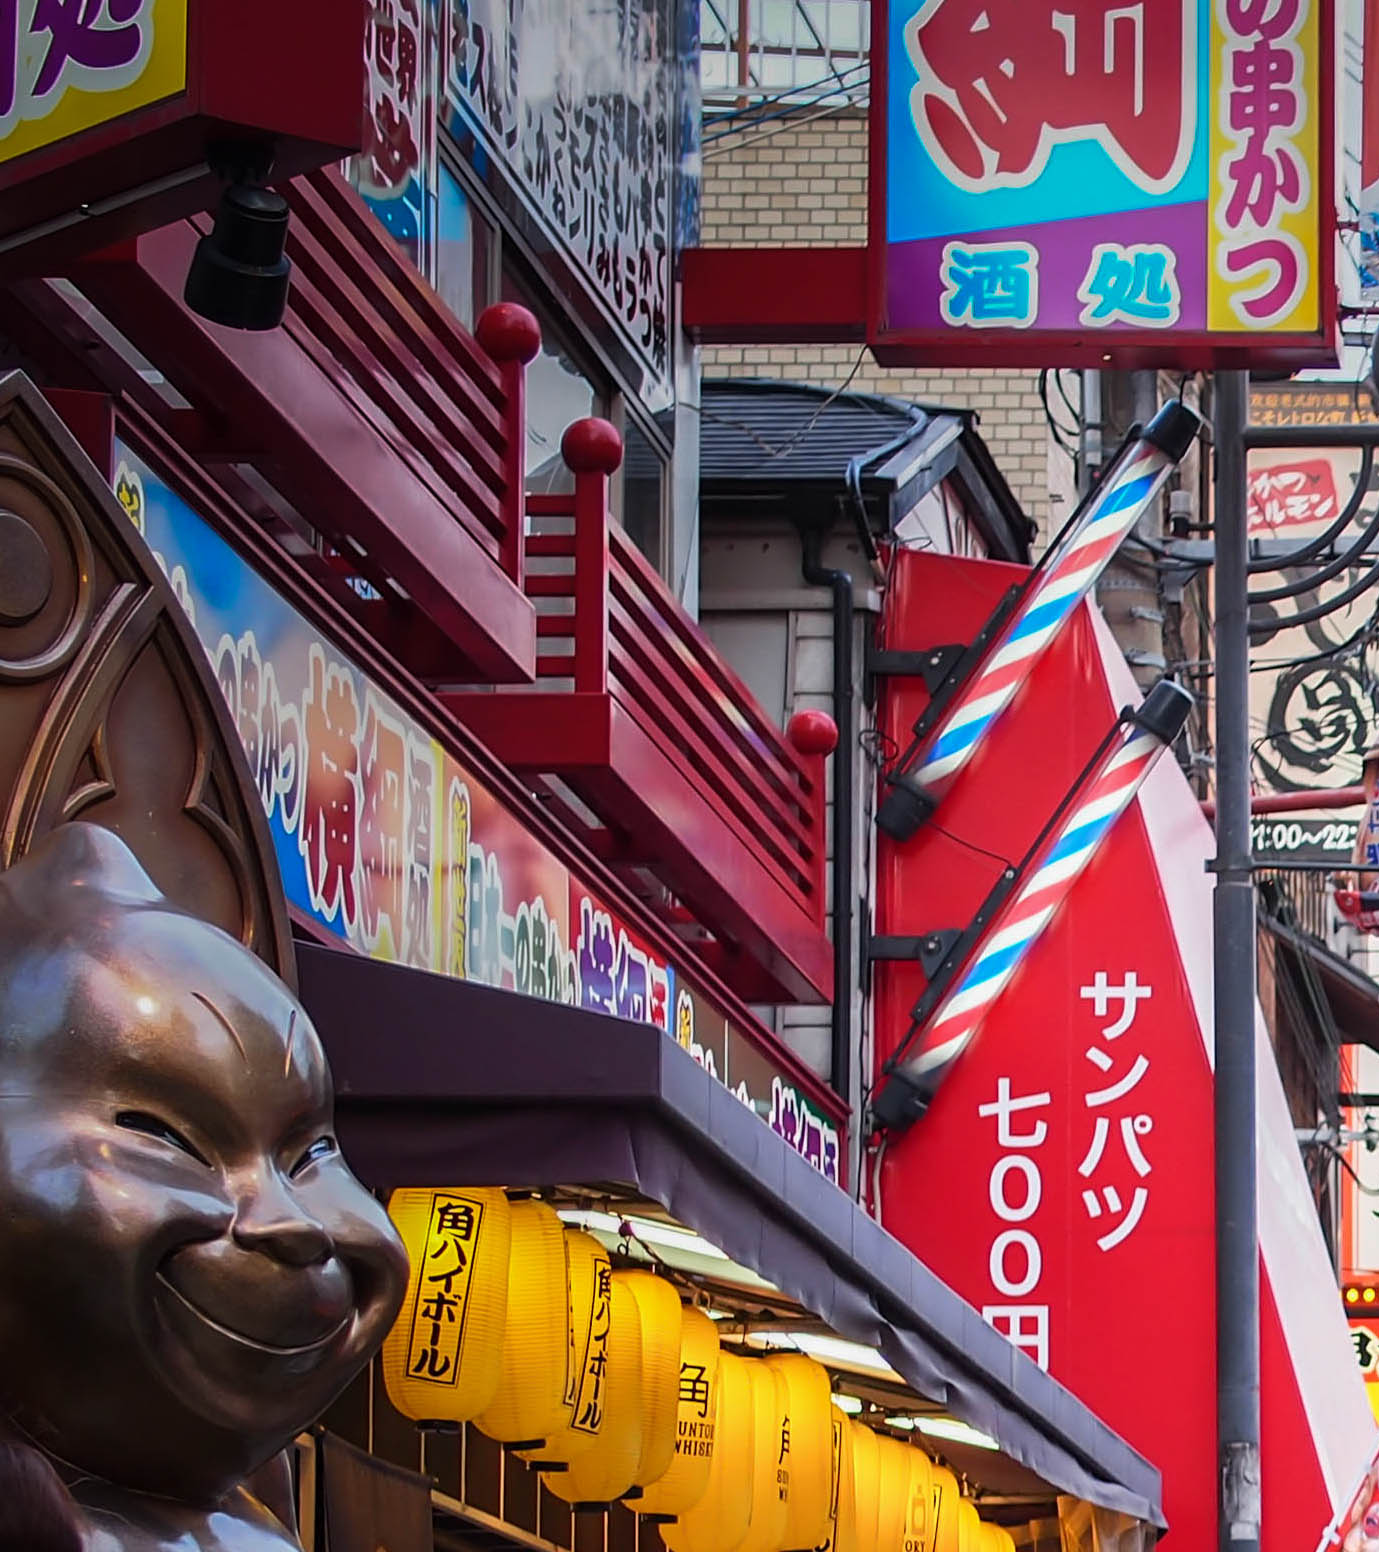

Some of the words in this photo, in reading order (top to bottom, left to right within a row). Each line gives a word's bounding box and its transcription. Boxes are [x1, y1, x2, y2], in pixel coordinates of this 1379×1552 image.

[947, 249, 1172, 323] 酒処
[1077, 971, 1152, 1252] サンパツ
[412, 1202, 474, 1378] 角ハイボール
